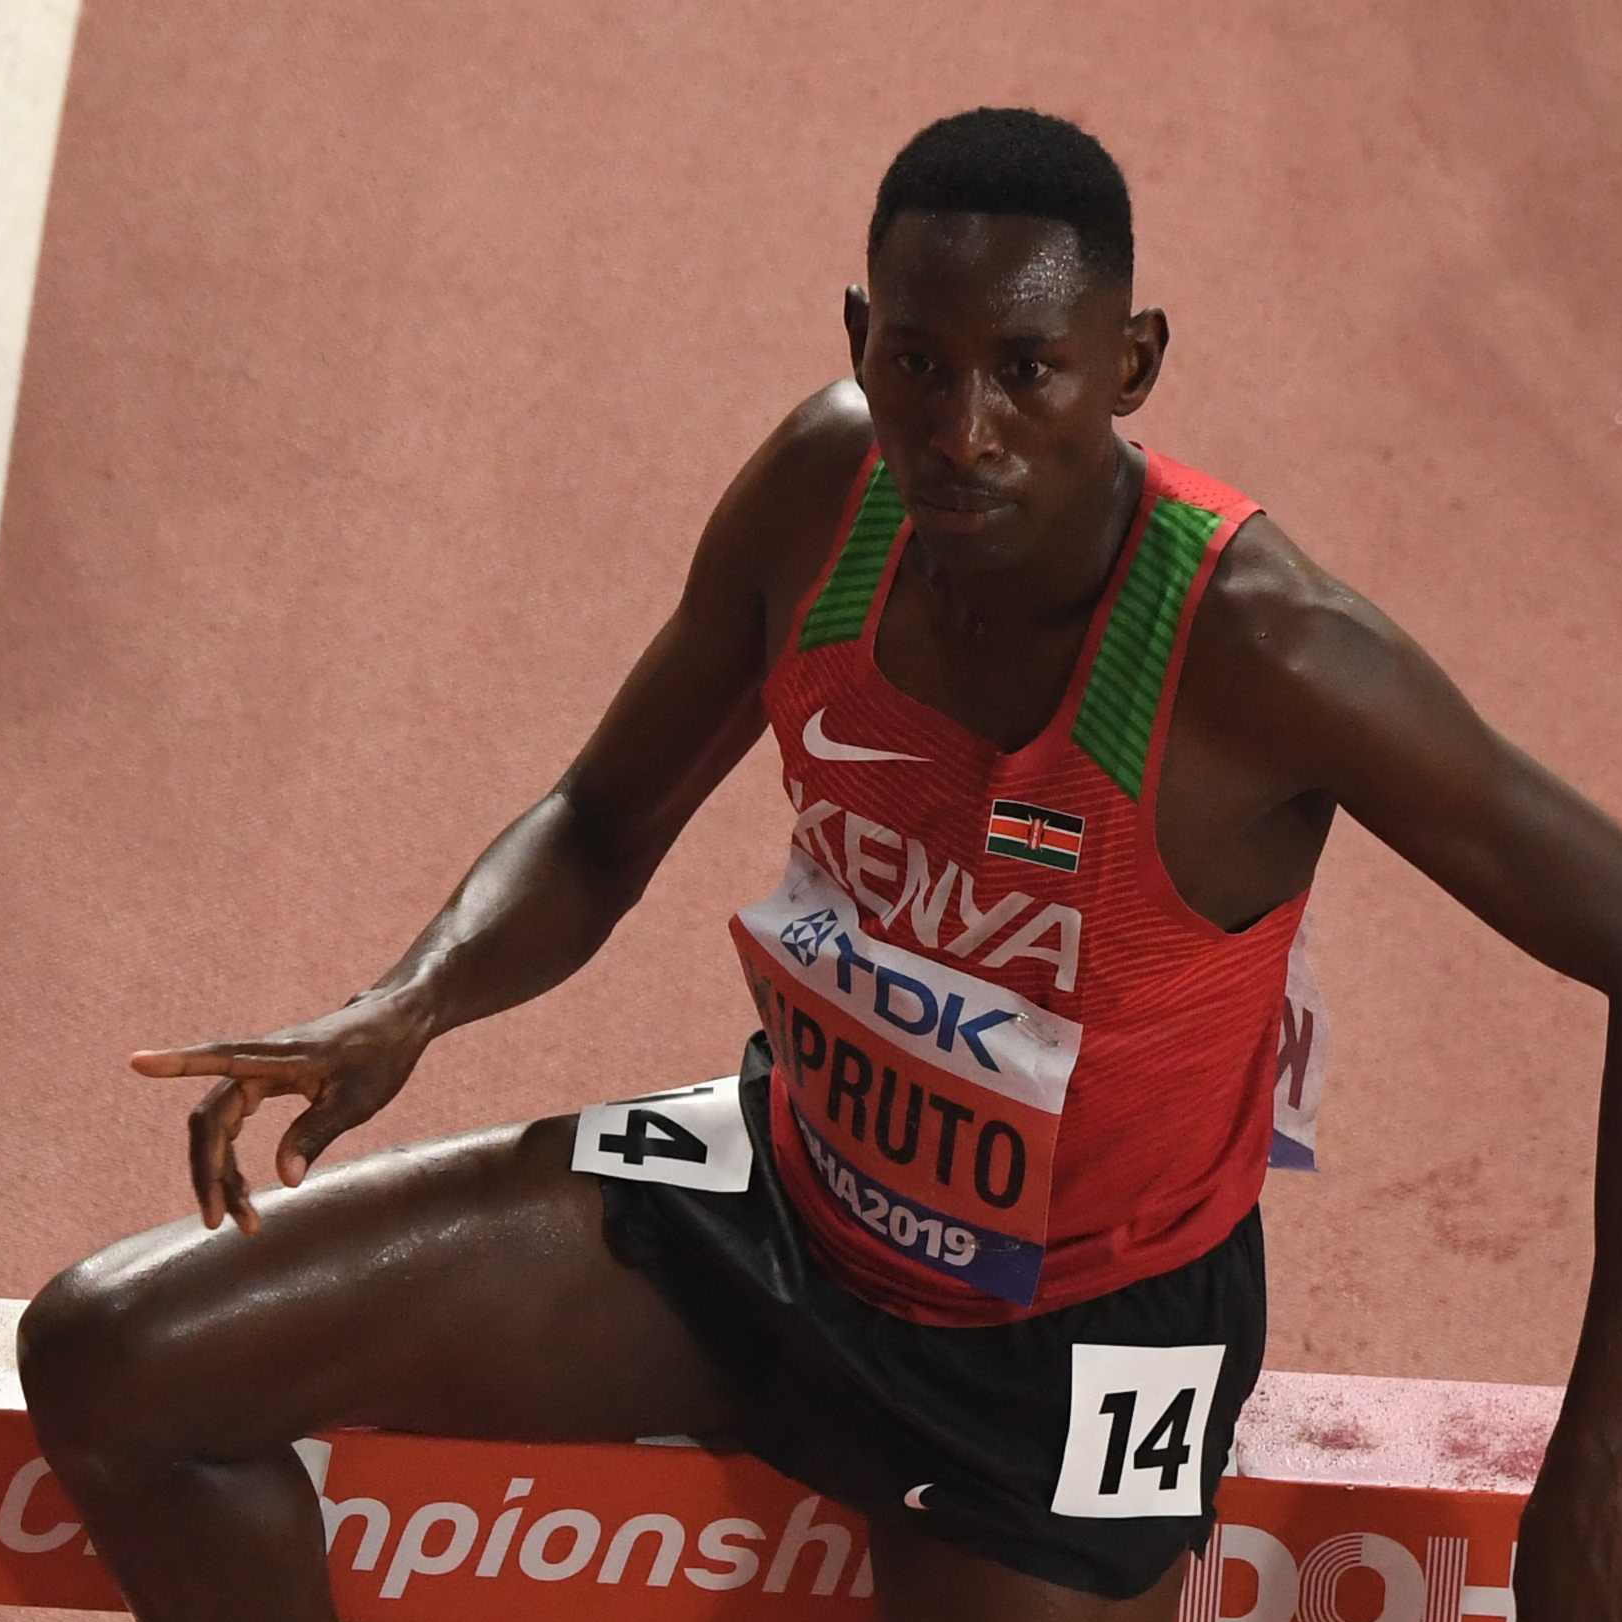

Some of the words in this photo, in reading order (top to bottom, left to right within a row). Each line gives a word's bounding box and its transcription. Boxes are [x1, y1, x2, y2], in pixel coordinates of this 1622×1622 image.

[789, 777, 1082, 992] KENYA
[834, 931, 1019, 1074] TDK
[1098, 1387, 1197, 1495] 14
